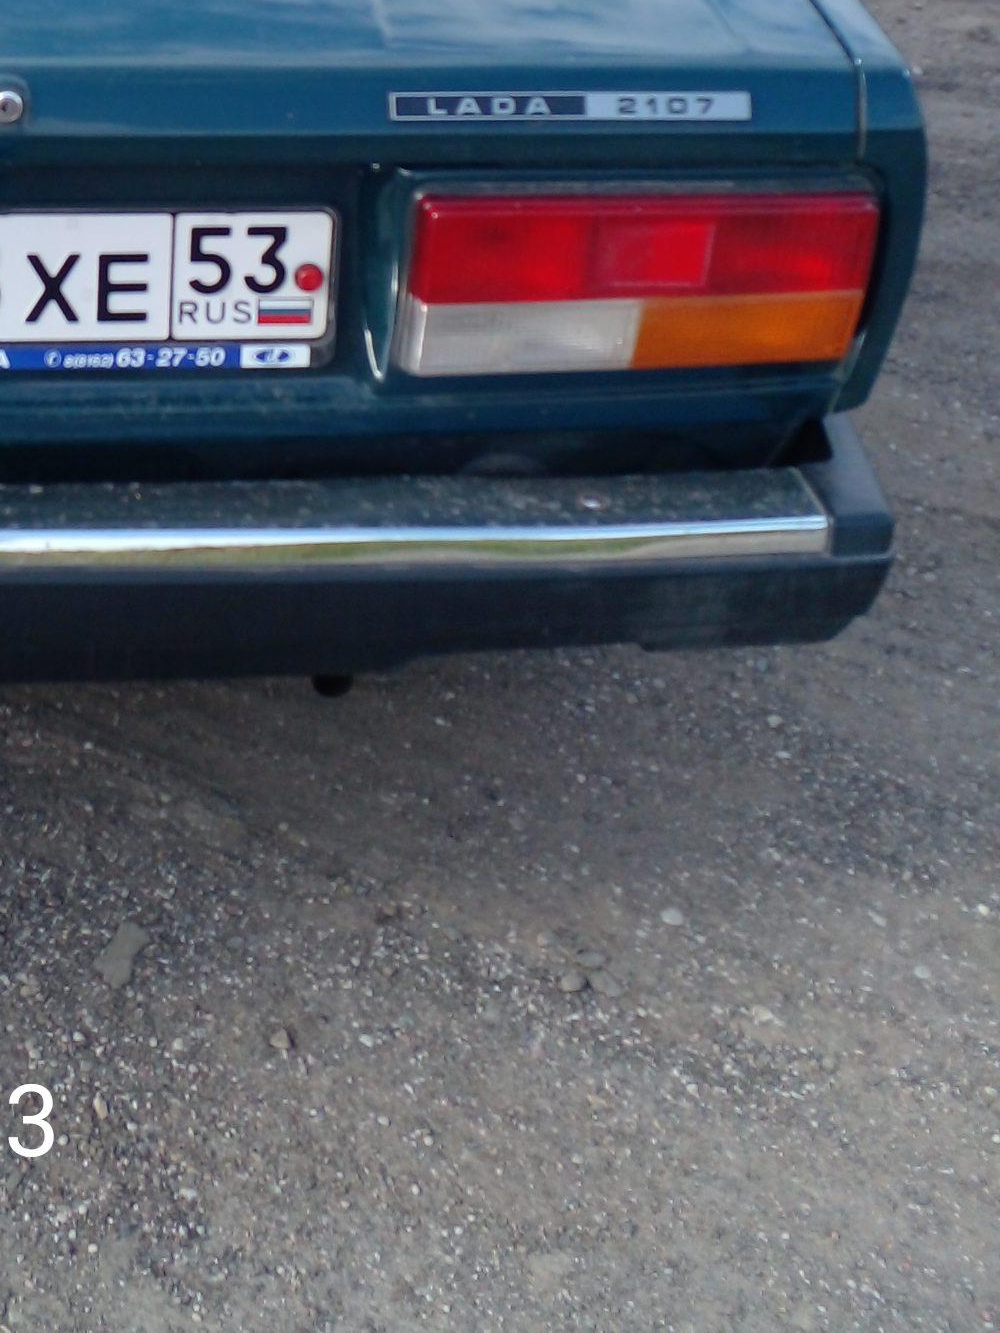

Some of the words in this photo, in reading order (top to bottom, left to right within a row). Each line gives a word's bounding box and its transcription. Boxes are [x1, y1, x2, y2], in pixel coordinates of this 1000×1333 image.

[426, 96, 552, 117] LADA
[615, 96, 716, 116] 2107
[188, 226, 288, 295] 53
[178, 300, 252, 325] RUS
